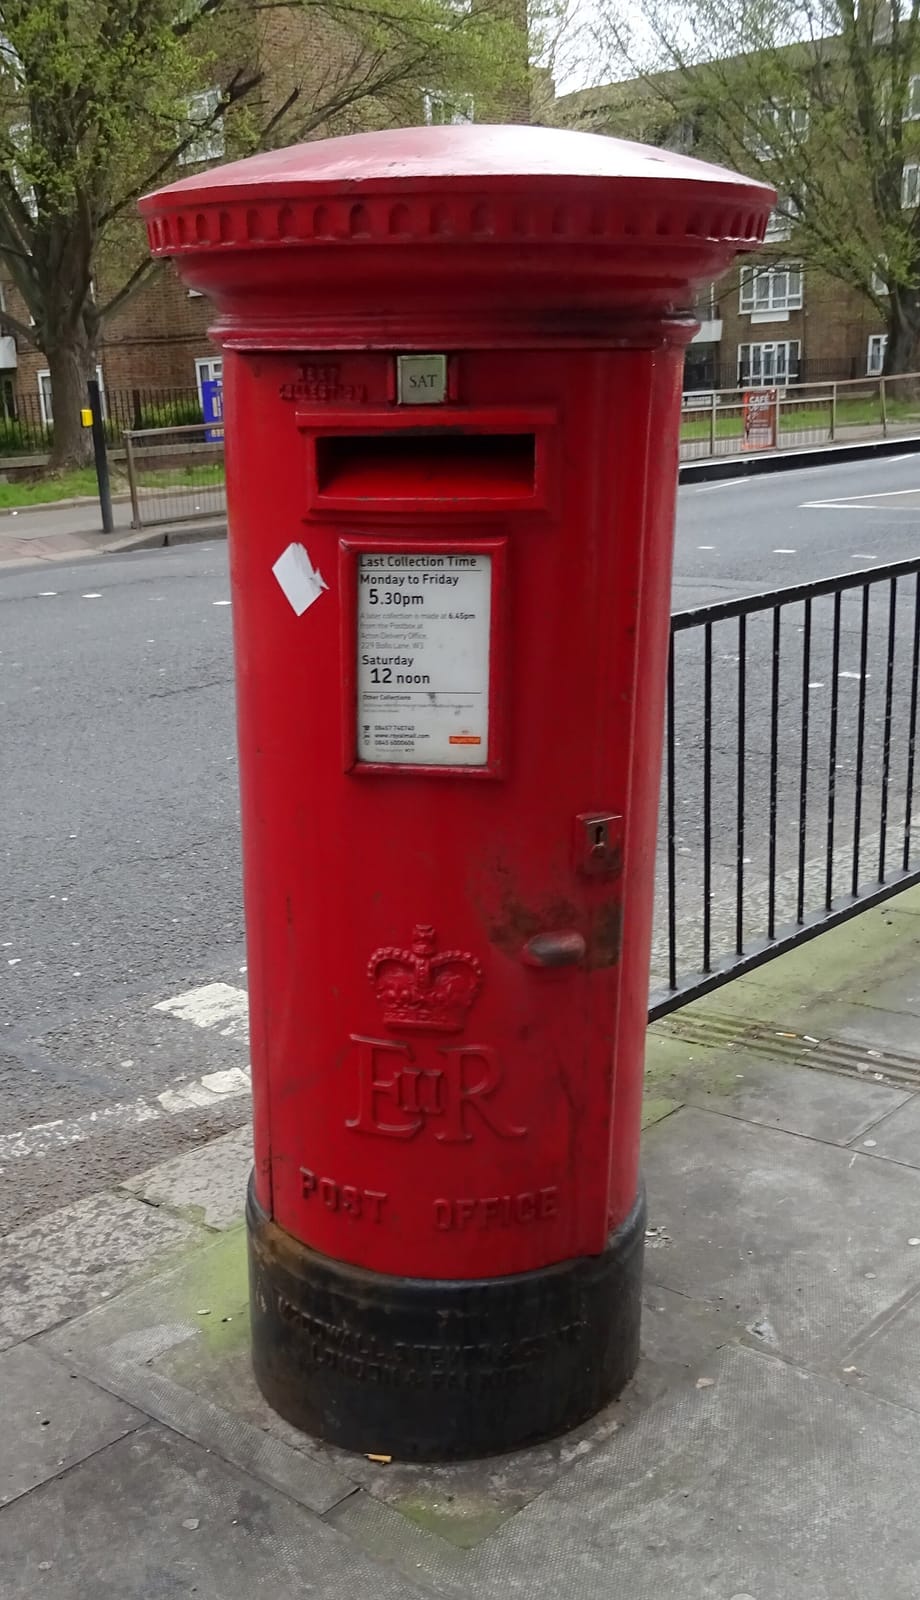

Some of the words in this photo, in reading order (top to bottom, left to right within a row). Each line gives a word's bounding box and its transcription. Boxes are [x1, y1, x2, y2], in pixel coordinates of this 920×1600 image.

[408, 373, 438, 389] SAT
[360, 555, 385, 567] Last
[387, 555, 444, 567] Collection
[447, 556, 477, 567] Time
[360, 573, 405, 587] Monday
[408, 575, 419, 585] to
[422, 573, 459, 587] Friday
[369, 588, 424, 607] 5.30pm
[448, 612, 476, 620] 6.45pm
[362, 655, 414, 667] Saturday
[370, 668, 392, 684] 12
[396, 674, 431, 684] noon
[299, 1166, 389, 1223] POST
[433, 1185, 559, 1231] OFFICE
